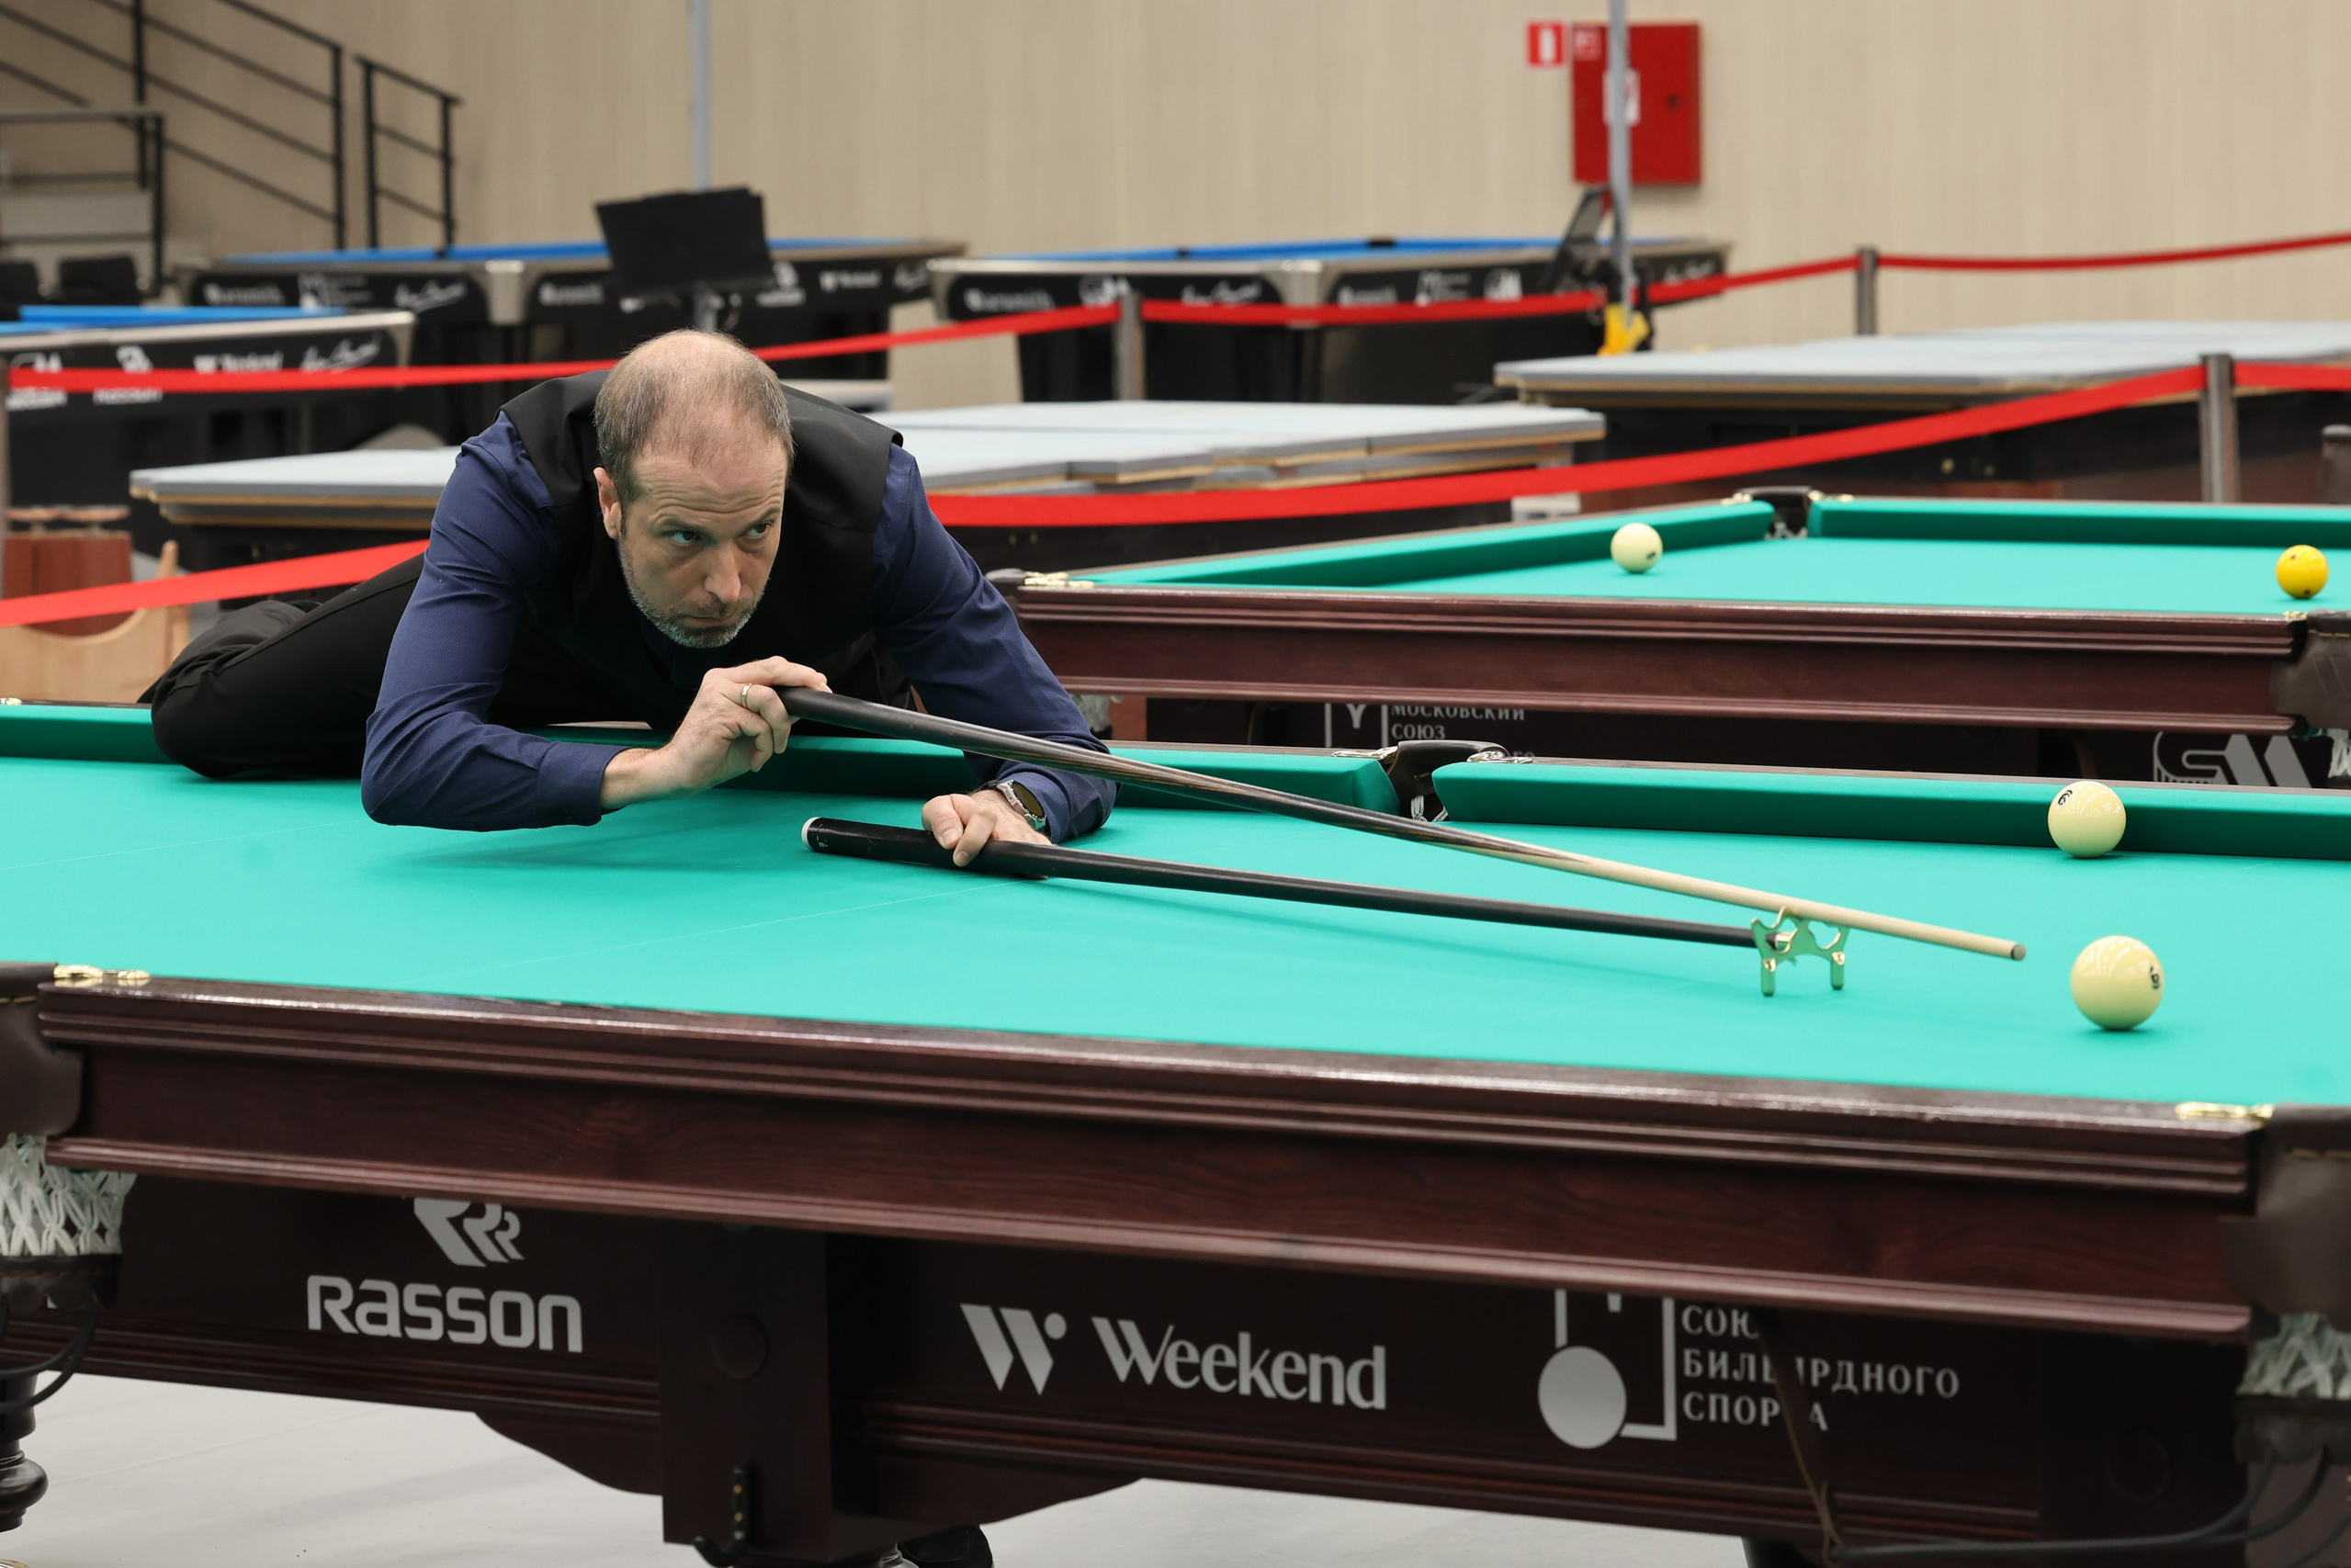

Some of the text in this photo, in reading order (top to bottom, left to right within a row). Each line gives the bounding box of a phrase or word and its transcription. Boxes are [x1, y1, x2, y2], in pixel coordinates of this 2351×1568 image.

[1391, 723, 1445, 740] СОЮЗ
[1681, 1304, 1760, 1339] СОЮ
[1091, 1315, 1386, 1410] Weekend
[1682, 1391, 1829, 1432] СПОРА
